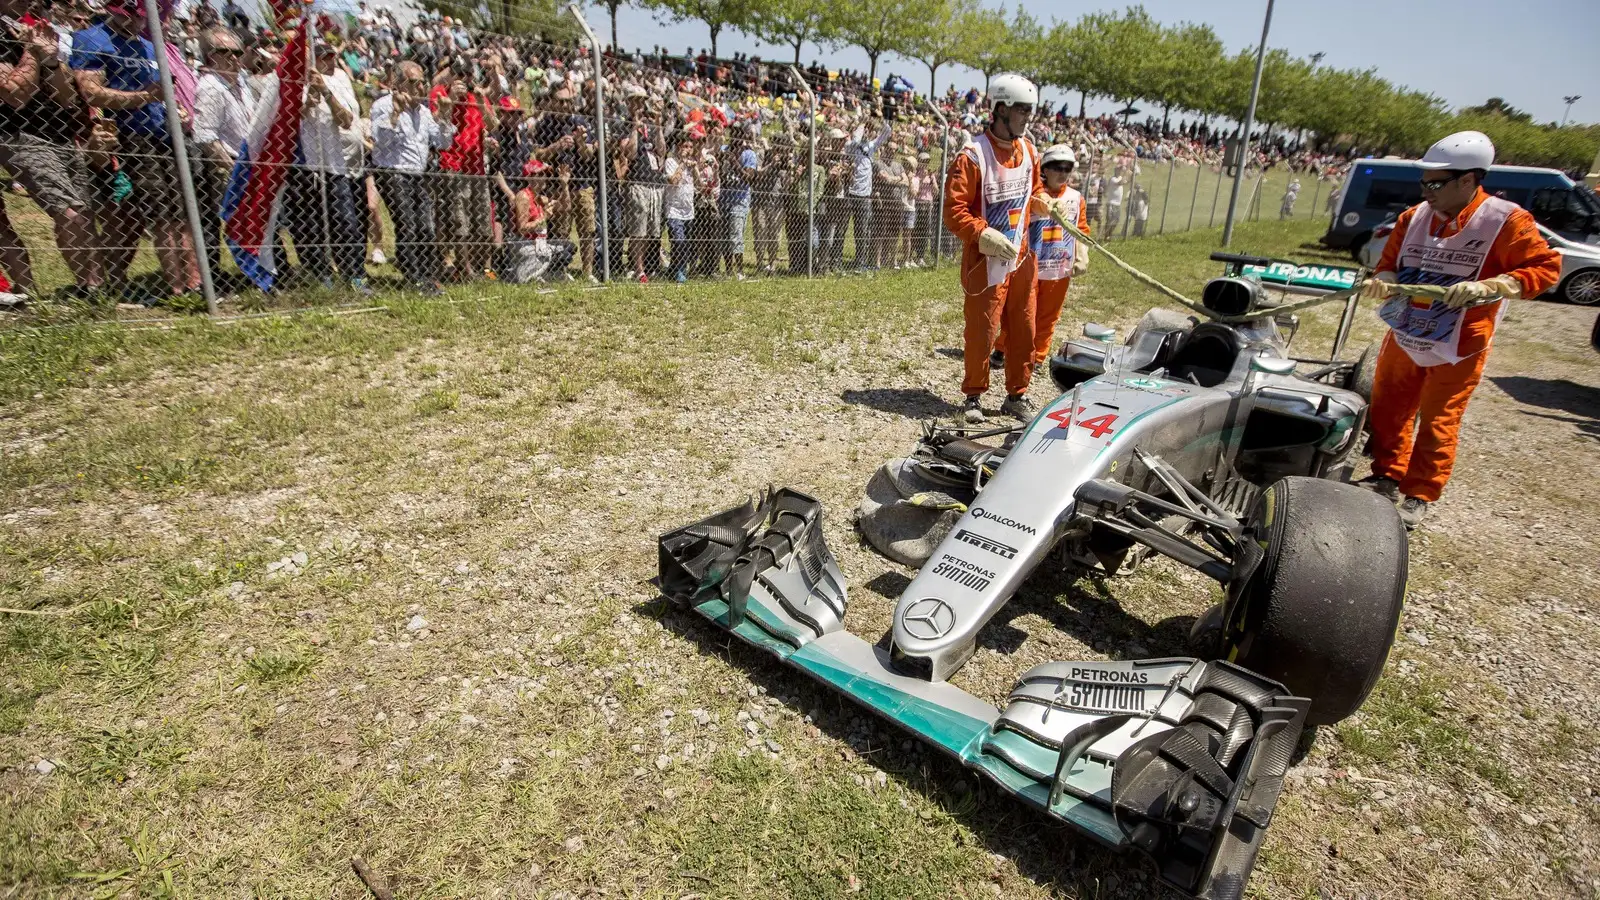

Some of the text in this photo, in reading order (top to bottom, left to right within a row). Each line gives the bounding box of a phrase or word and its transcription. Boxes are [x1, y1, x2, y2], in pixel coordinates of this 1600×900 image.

[1046, 406, 1119, 438] 44
[971, 507, 1036, 536] QUALCOMM
[954, 529, 1019, 560] PIRELLI
[932, 562, 991, 592] SYNTIUM
[942, 553, 996, 579] PETRONAS
[1071, 667, 1148, 684] PETRONAS
[1070, 683, 1145, 710] SYNTIUM
